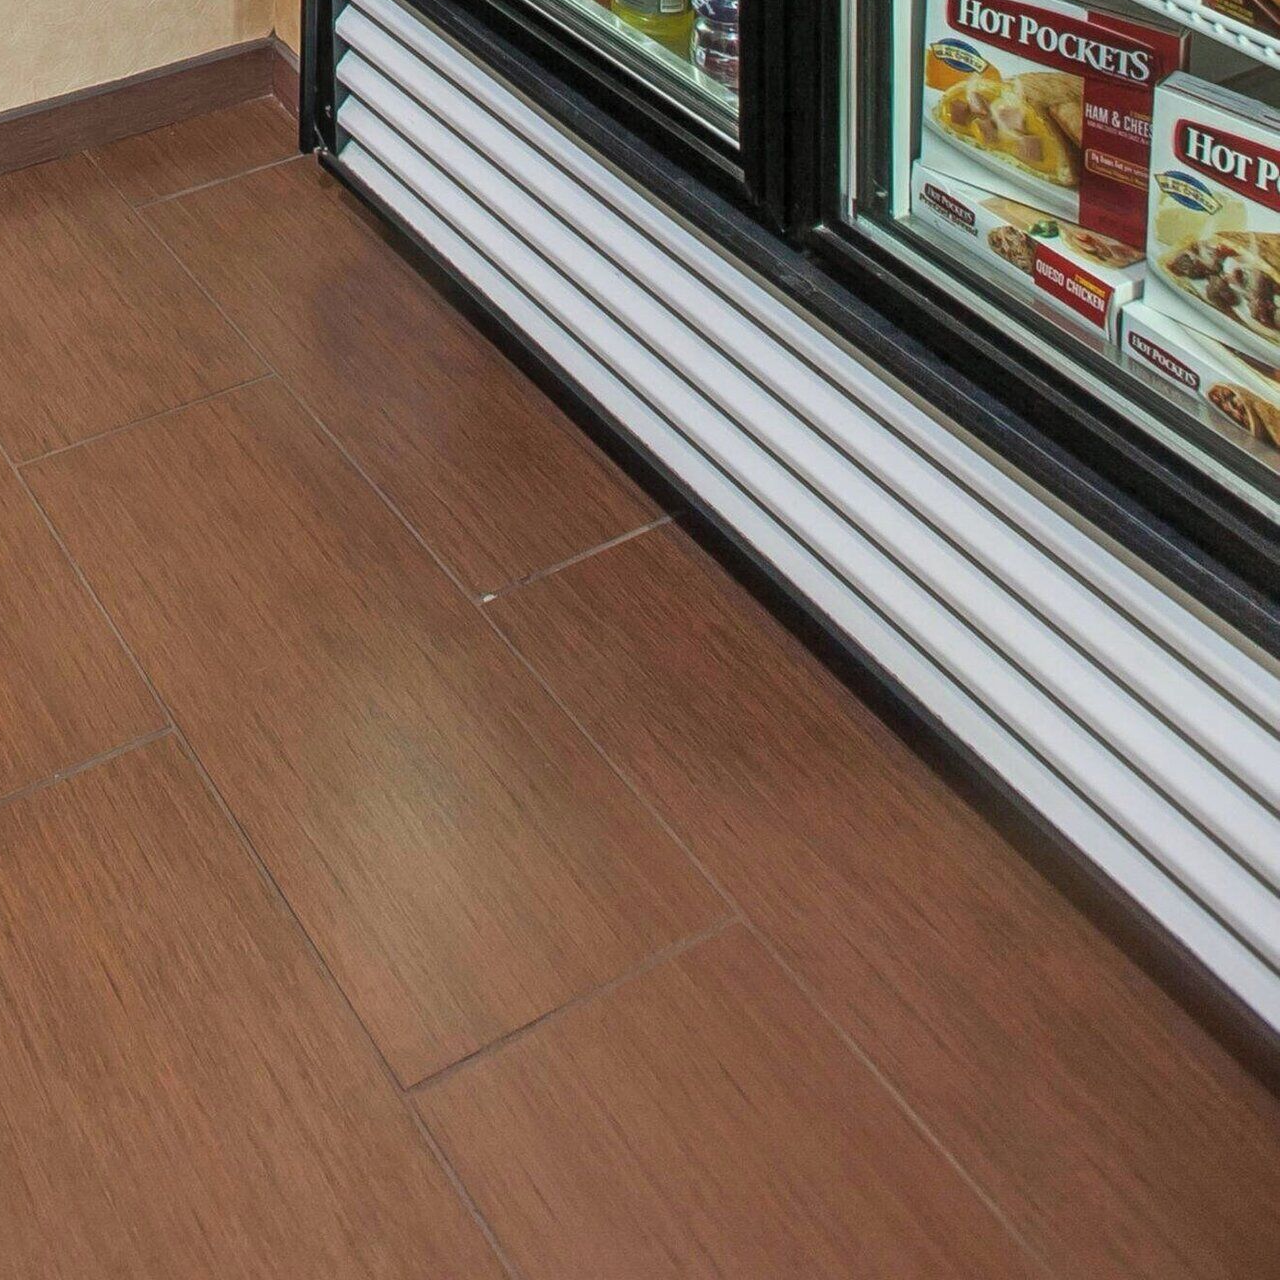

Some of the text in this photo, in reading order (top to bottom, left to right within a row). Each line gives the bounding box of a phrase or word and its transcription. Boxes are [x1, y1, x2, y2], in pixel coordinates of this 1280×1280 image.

[1019, 14, 1151, 83] POCKETS
[1085, 102, 1120, 128] HAM &
[1186, 126, 1253, 181] HOT
[1035, 257, 1106, 312] QUESO CHICKEN
[1131, 333, 1198, 387] HOT POCKETS
